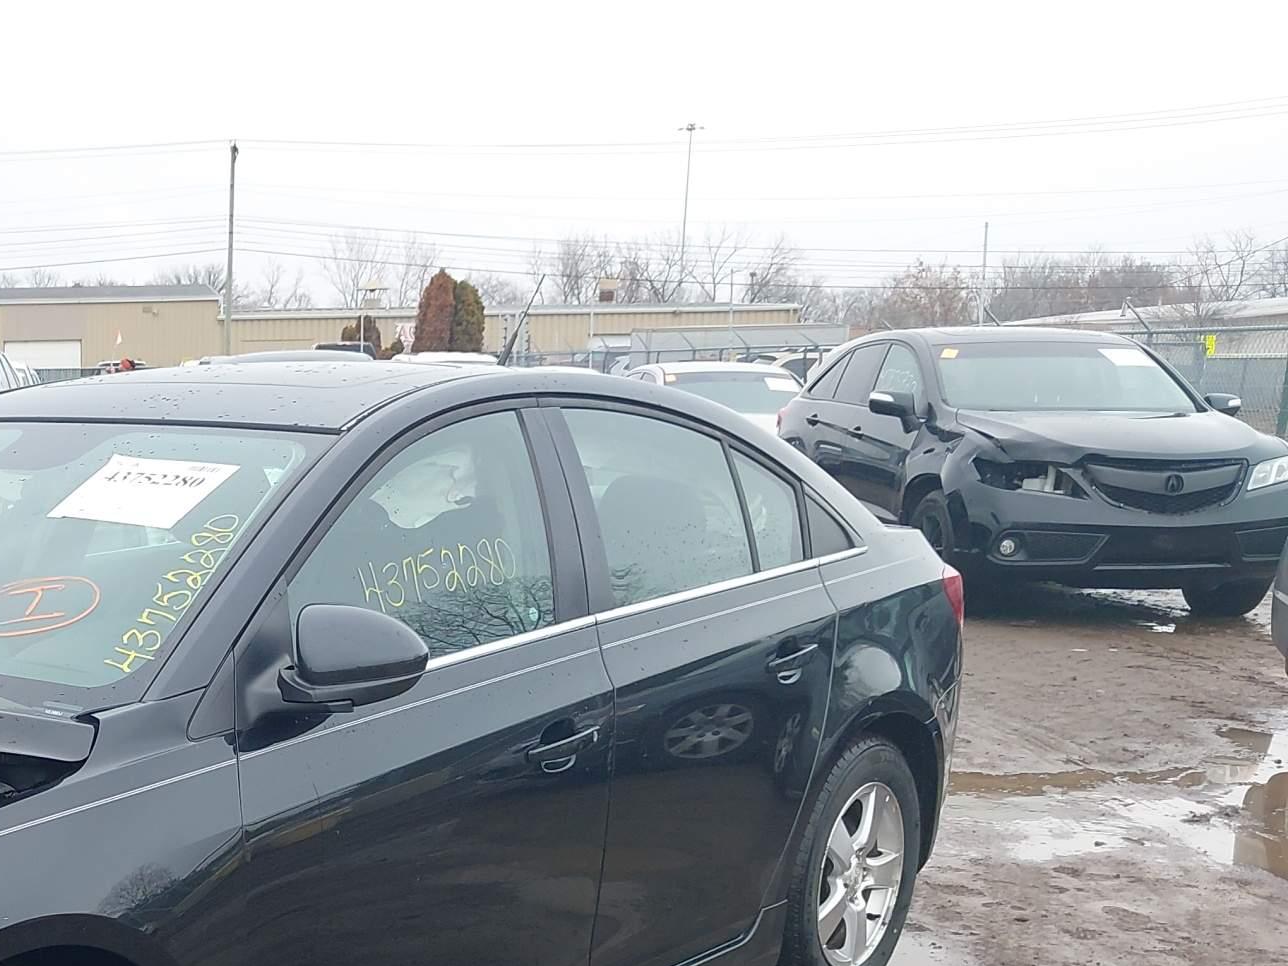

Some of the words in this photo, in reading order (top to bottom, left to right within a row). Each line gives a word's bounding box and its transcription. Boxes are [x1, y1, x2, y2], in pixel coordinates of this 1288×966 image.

[104, 470, 206, 489] 43752280
[103, 514, 239, 673] 43752280
[358, 538, 516, 613] 43752280
